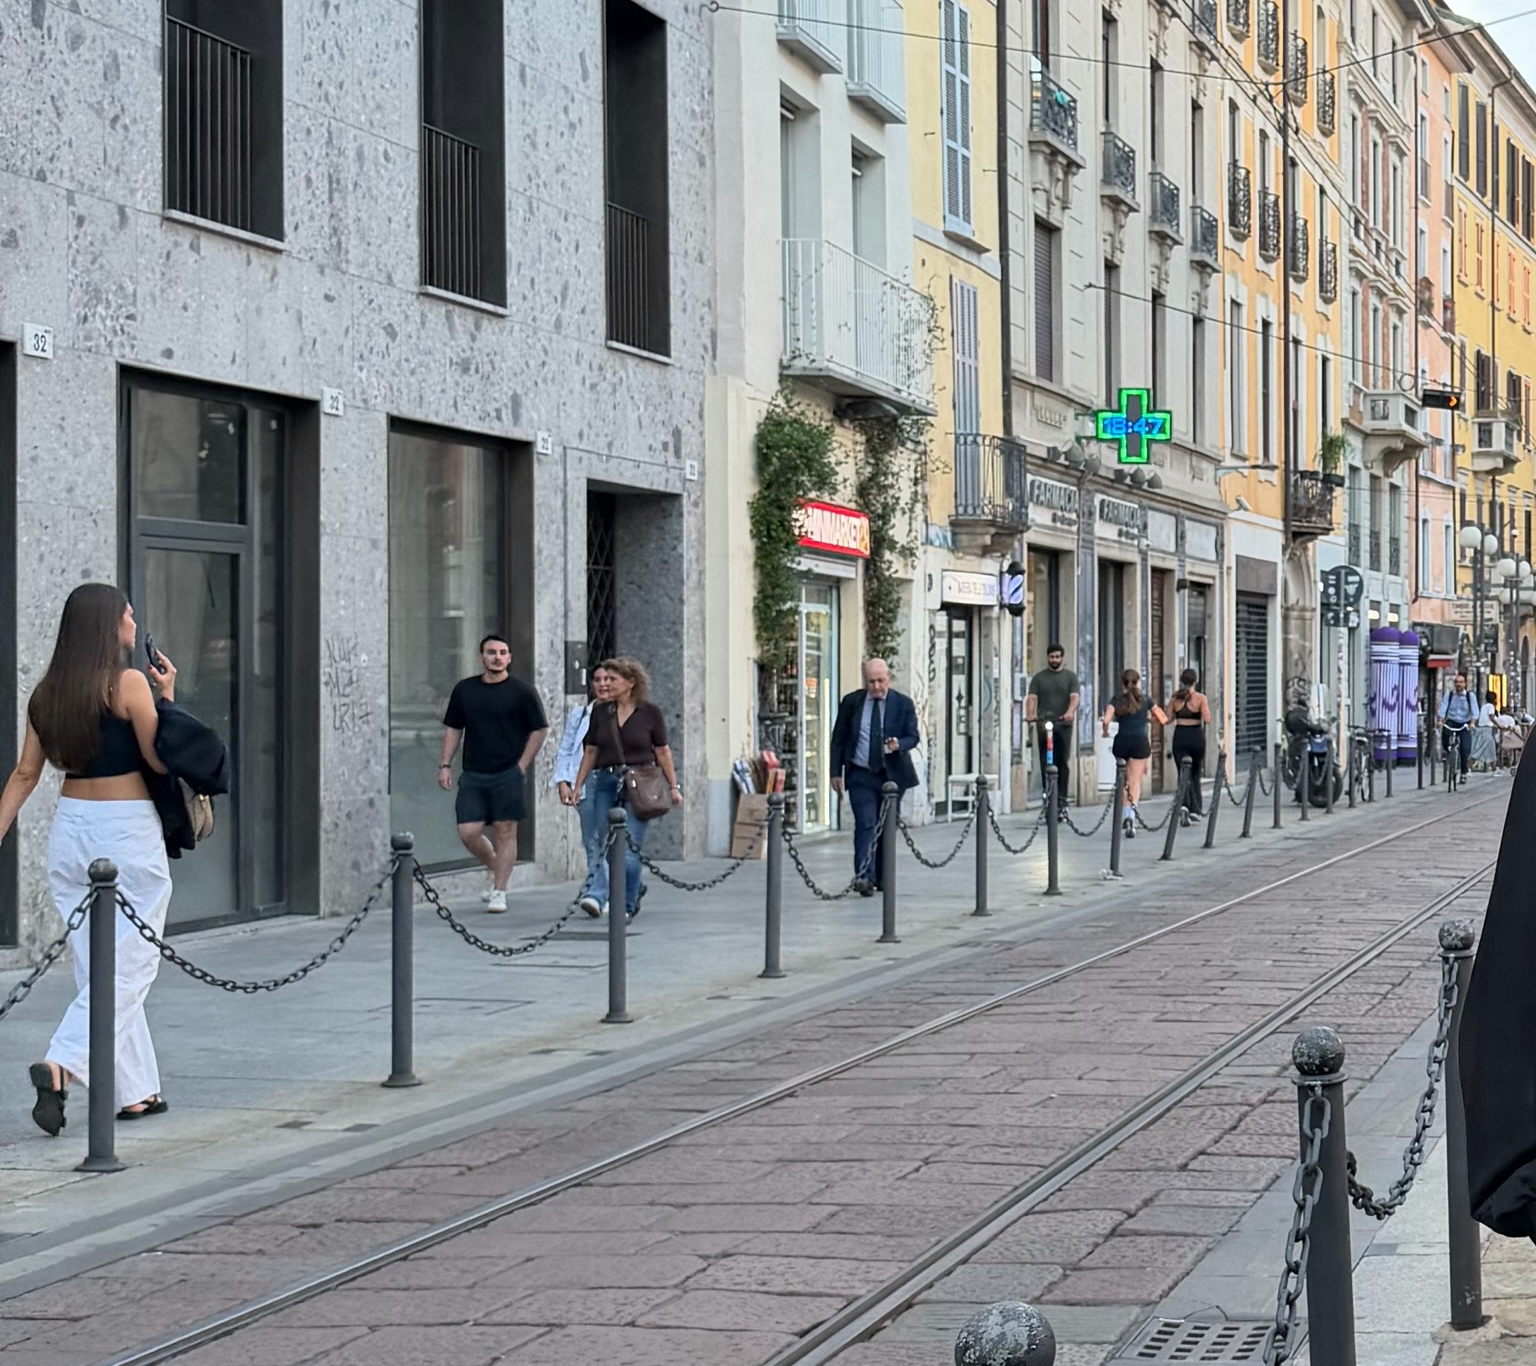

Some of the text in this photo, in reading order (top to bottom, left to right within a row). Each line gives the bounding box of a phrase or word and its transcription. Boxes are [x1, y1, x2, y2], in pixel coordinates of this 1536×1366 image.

[33, 333, 47, 353] 32
[1103, 417, 1164, 435] 18:47
[1033, 480, 1079, 514] FARMACIA
[1101, 499, 1141, 529] FARMACIA
